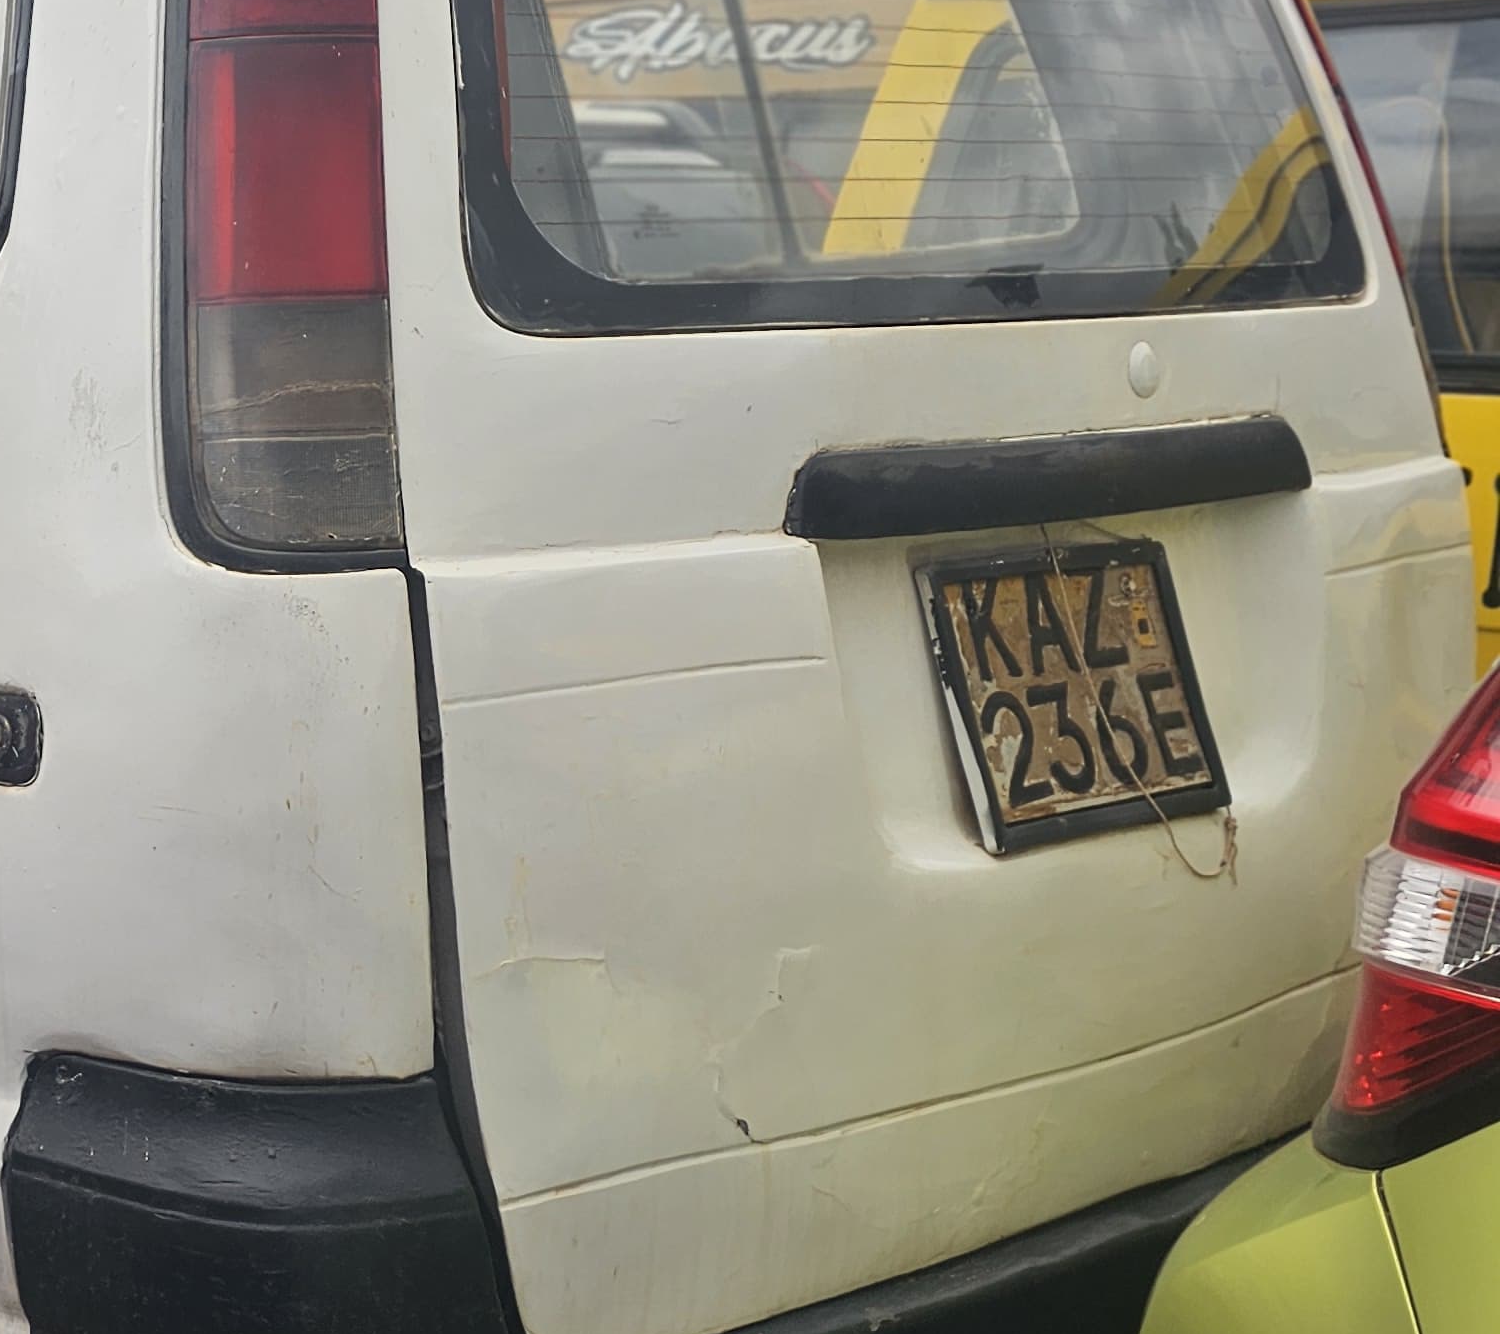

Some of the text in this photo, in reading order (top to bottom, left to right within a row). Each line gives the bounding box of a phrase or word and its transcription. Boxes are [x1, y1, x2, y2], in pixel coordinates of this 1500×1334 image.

[564, 0, 871, 82] Abacus
[960, 568, 1130, 680] KAZ
[980, 671, 1202, 807] 236E
